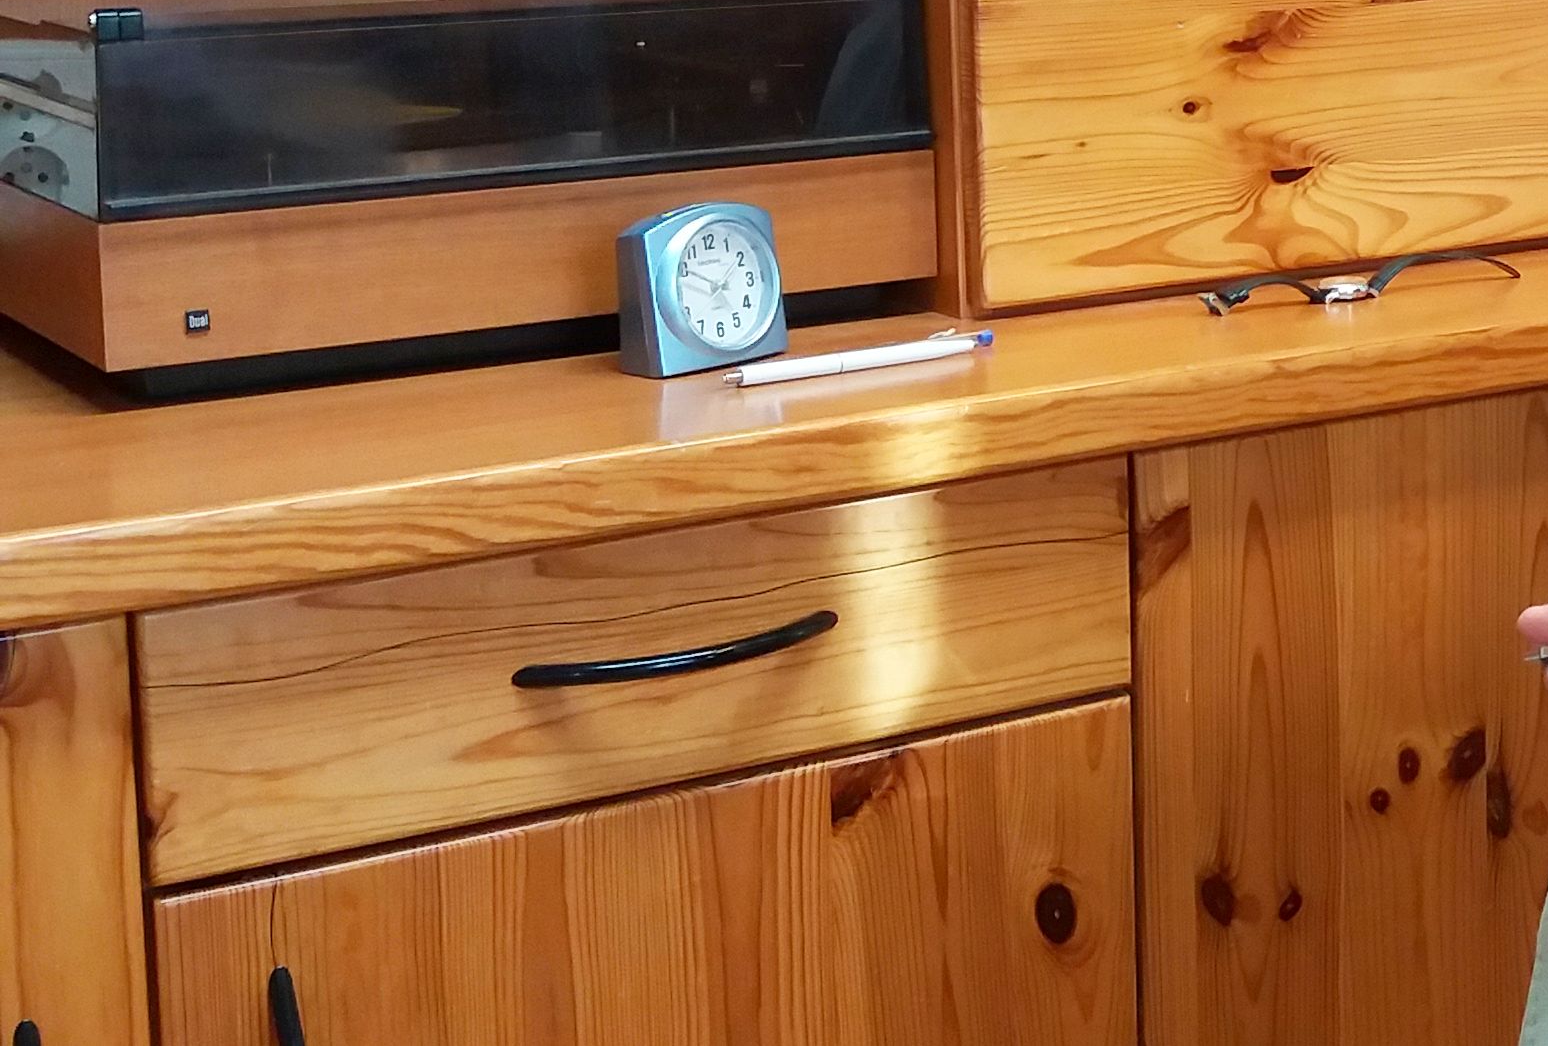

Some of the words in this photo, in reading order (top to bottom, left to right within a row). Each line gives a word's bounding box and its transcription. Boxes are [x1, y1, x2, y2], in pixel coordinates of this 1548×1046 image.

[702, 233, 716, 251] 12
[723, 237, 730, 253] 1
[687, 244, 697, 260] 11
[736, 251, 745, 267] 2
[745, 271, 755, 287] 3
[742, 294, 752, 309] 4
[188, 313, 209, 329] Dual
[696, 319, 705, 335] 7
[732, 312, 741, 328] 5
[716, 321, 725, 337] 6
